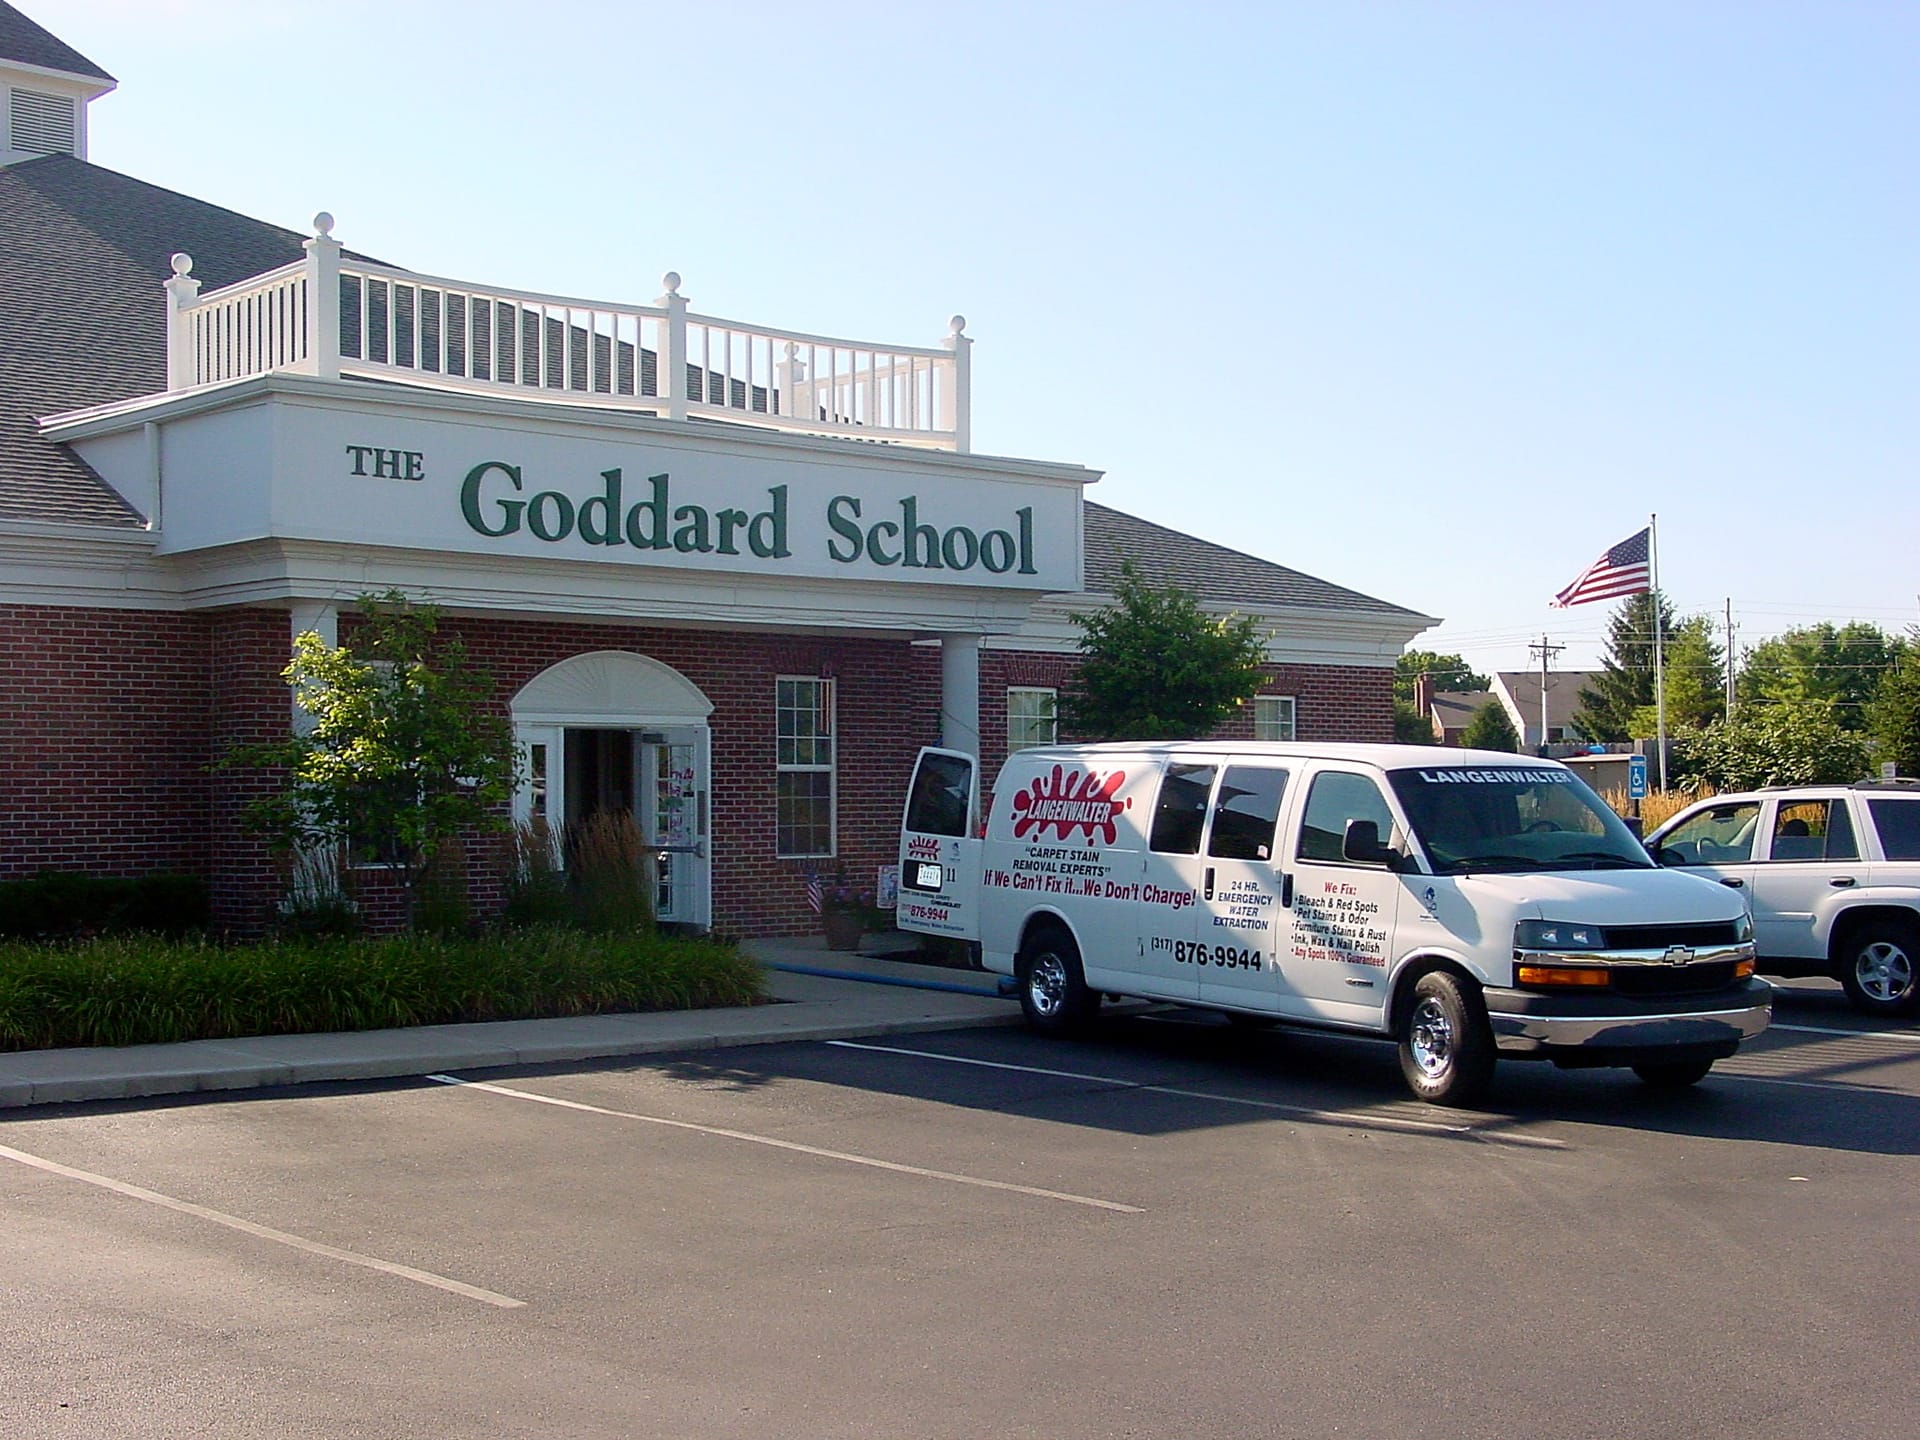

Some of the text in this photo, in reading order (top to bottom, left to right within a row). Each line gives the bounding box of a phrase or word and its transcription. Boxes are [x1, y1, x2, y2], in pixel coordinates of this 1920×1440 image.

[346, 445, 425, 481] THE
[460, 461, 1038, 575] Goddard School
[1419, 771, 1572, 783] LANGENWALTER
[1027, 799, 1111, 823] LANGENWALTER
[1070, 850, 1100, 862] STAIN
[1013, 860, 1057, 873] REMOVAL
[947, 867, 956, 882] 11
[984, 869, 992, 886] If
[994, 871, 1009, 887] We
[1013, 872, 1042, 890] Can't
[1045, 876, 1061, 893] Fix
[1105, 881, 1139, 900] Don't
[1143, 884, 1197, 910] Charge!
[1231, 881, 1260, 892] 24 HR.
[1324, 882, 1357, 895] We Fix:
[1218, 892, 1273, 905] EMERGENCY
[911, 905, 948, 920] 876-9944
[1229, 906, 1259, 917] WATER
[1336, 899, 1352, 910] Red
[1354, 900, 1378, 914] Spots
[1213, 916, 1269, 930] EXTRACTION
[1297, 908, 1311, 918] Pet
[1312, 909, 1337, 922] Stains
[1348, 913, 1369, 925] Odor
[1295, 920, 1330, 934] Furniture
[1332, 925, 1356, 938] Stains
[1367, 929, 1386, 941] Rust
[1311, 935, 1326, 946] Wax
[1336, 938, 1353, 951] Nail
[1355, 940, 1380, 953] Polish
[1151, 937, 1262, 971] (317) 876-9944
[1295, 946, 1306, 960] Any
[1308, 947, 1326, 961] Spots
[1347, 953, 1385, 967] Guaranteed
